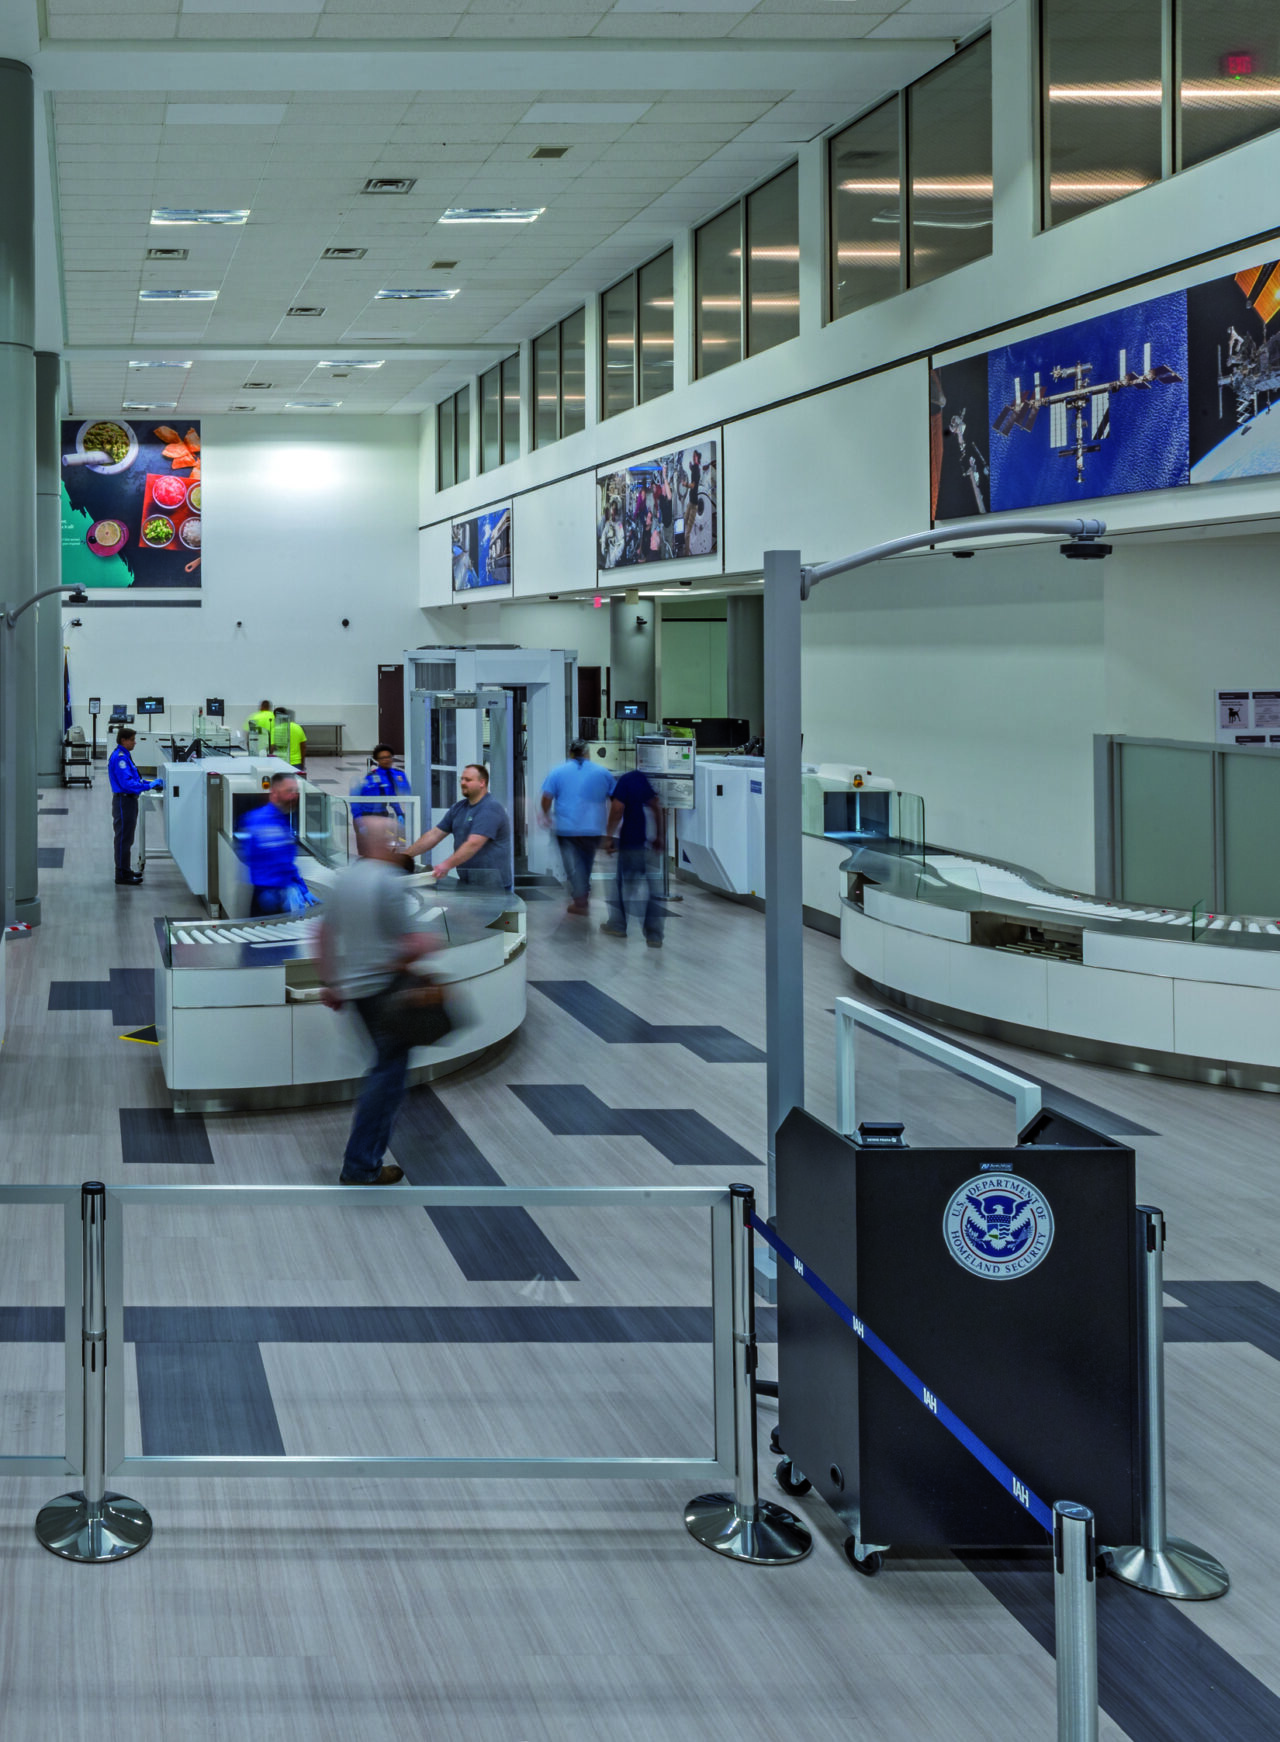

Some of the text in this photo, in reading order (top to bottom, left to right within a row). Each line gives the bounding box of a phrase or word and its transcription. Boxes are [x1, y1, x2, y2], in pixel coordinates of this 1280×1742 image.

[968, 1179, 1038, 1205] DEPARTMENT
[1036, 1206, 1047, 1220] OF
[793, 1255, 804, 1277] IAH
[951, 1230, 1047, 1273] HOMELAND SECURITY
[852, 1315, 864, 1338] IAH
[923, 1387, 937, 1414] IAH
[1012, 1476, 1029, 1508] IAH
